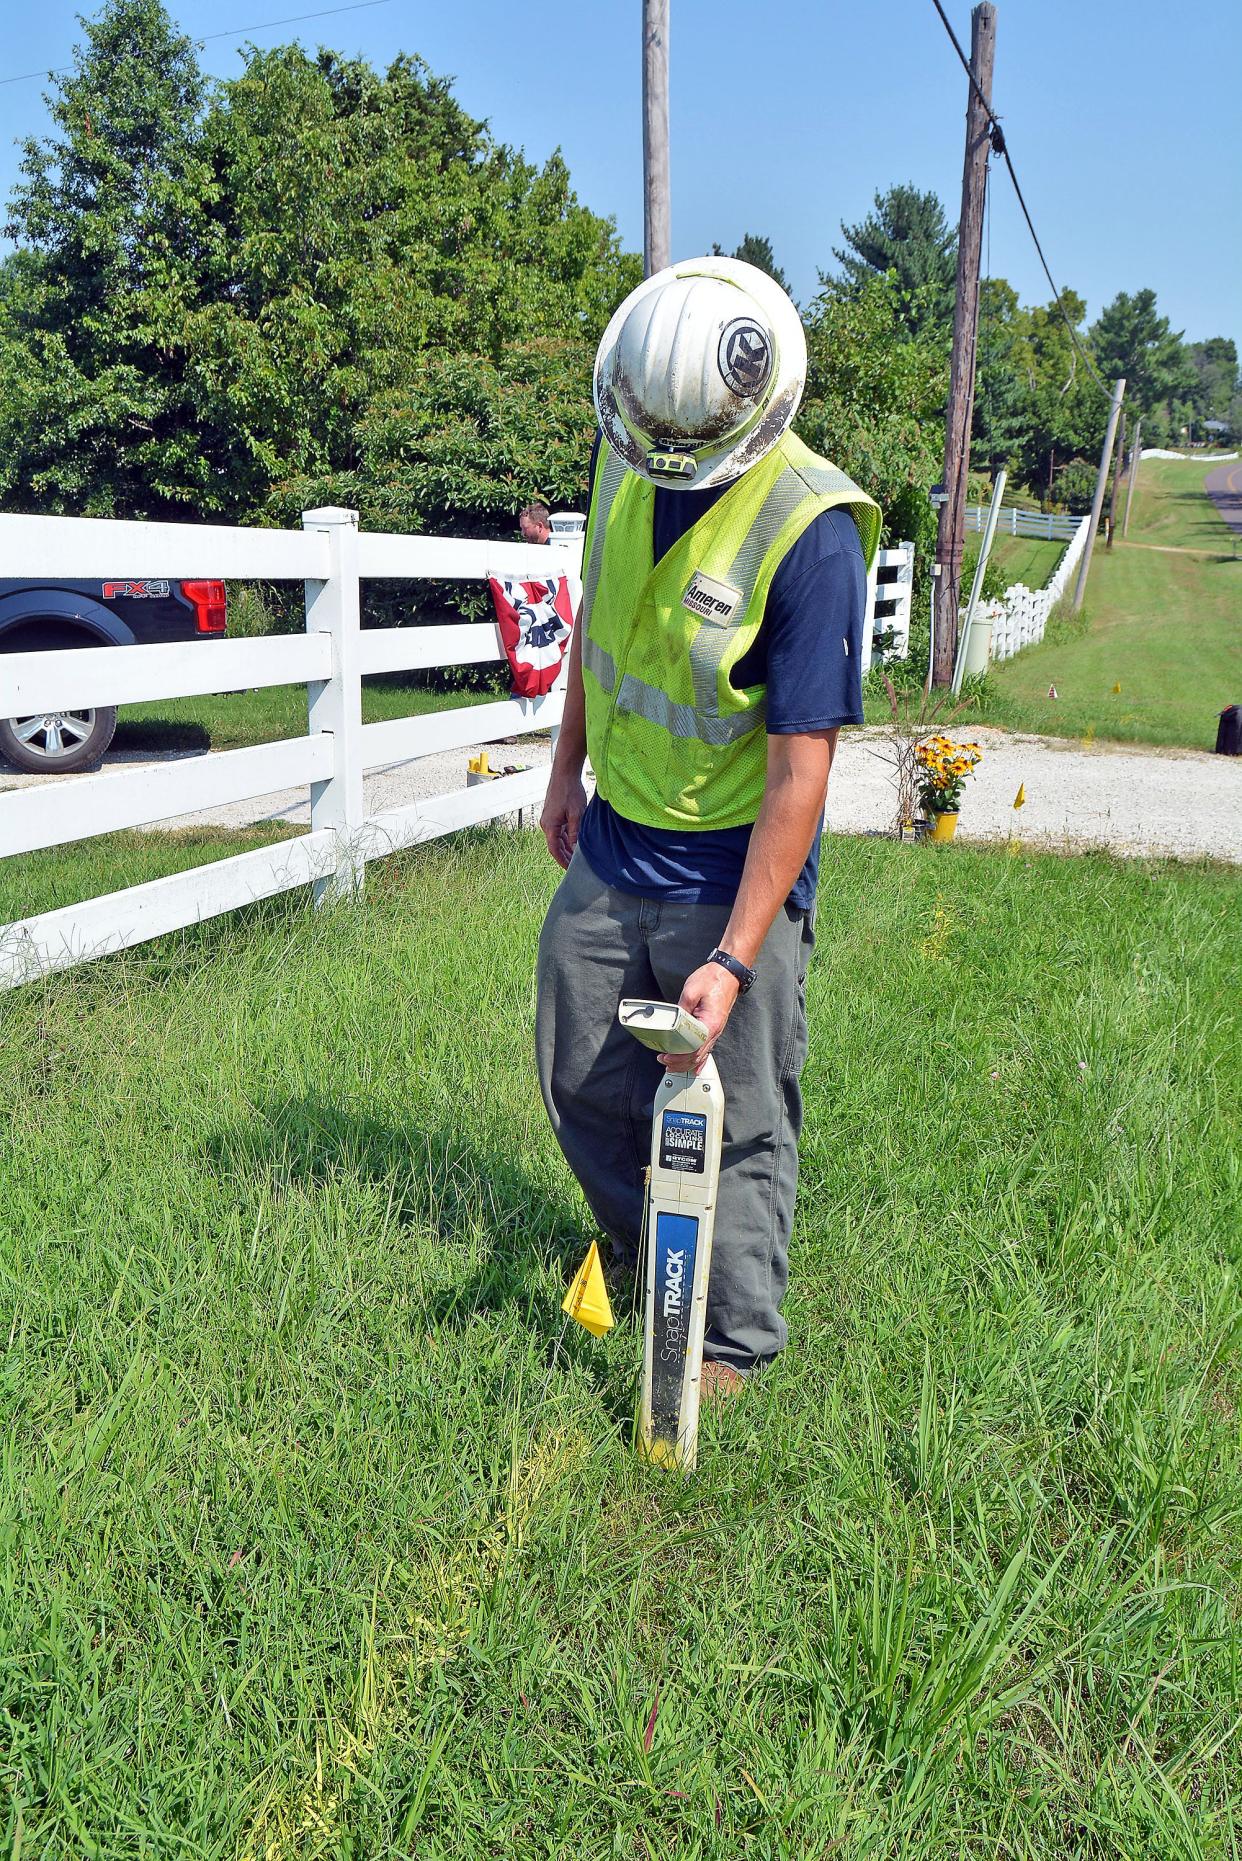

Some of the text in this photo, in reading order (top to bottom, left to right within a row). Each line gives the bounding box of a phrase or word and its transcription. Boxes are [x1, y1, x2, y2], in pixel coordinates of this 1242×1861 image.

[102, 580, 170, 599] FX4
[687, 585, 732, 616] Ameren
[665, 1126, 704, 1138] ACCURATE
[669, 1138, 703, 1151] SIMPLE
[660, 1247, 684, 1363] SnapTRACK
